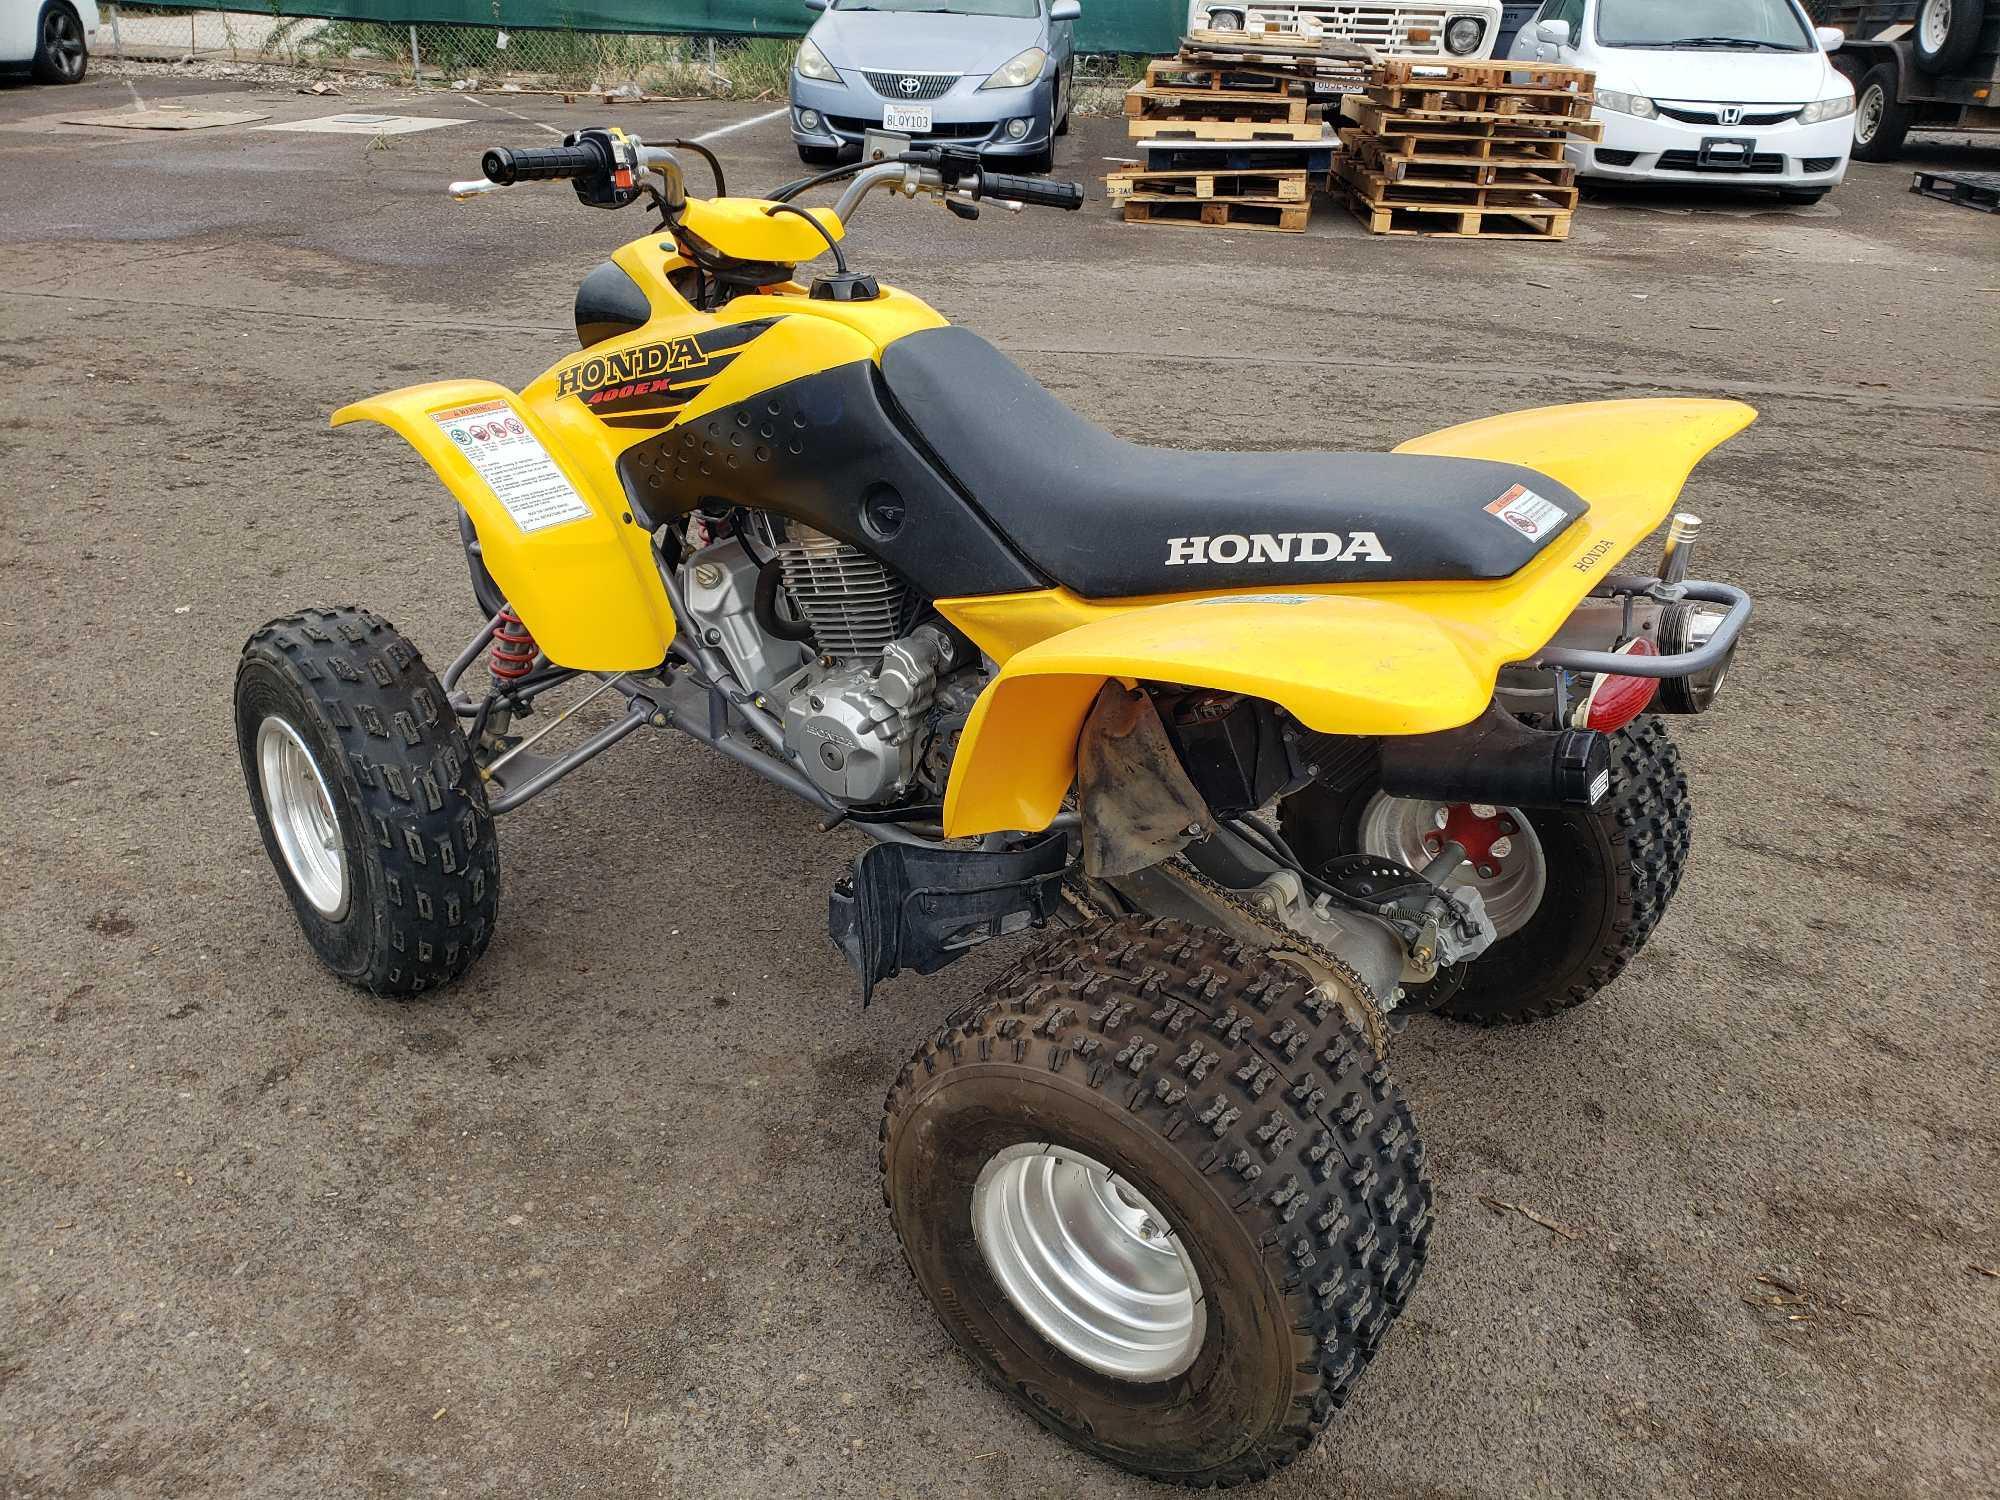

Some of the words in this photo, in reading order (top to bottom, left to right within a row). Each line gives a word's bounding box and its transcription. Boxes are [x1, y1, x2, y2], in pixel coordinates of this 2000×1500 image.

[556, 335, 709, 400] HONDA
[588, 378, 672, 404] 400EX
[1165, 531, 1392, 566] HONDA
[1574, 539, 1614, 572] HONDA
